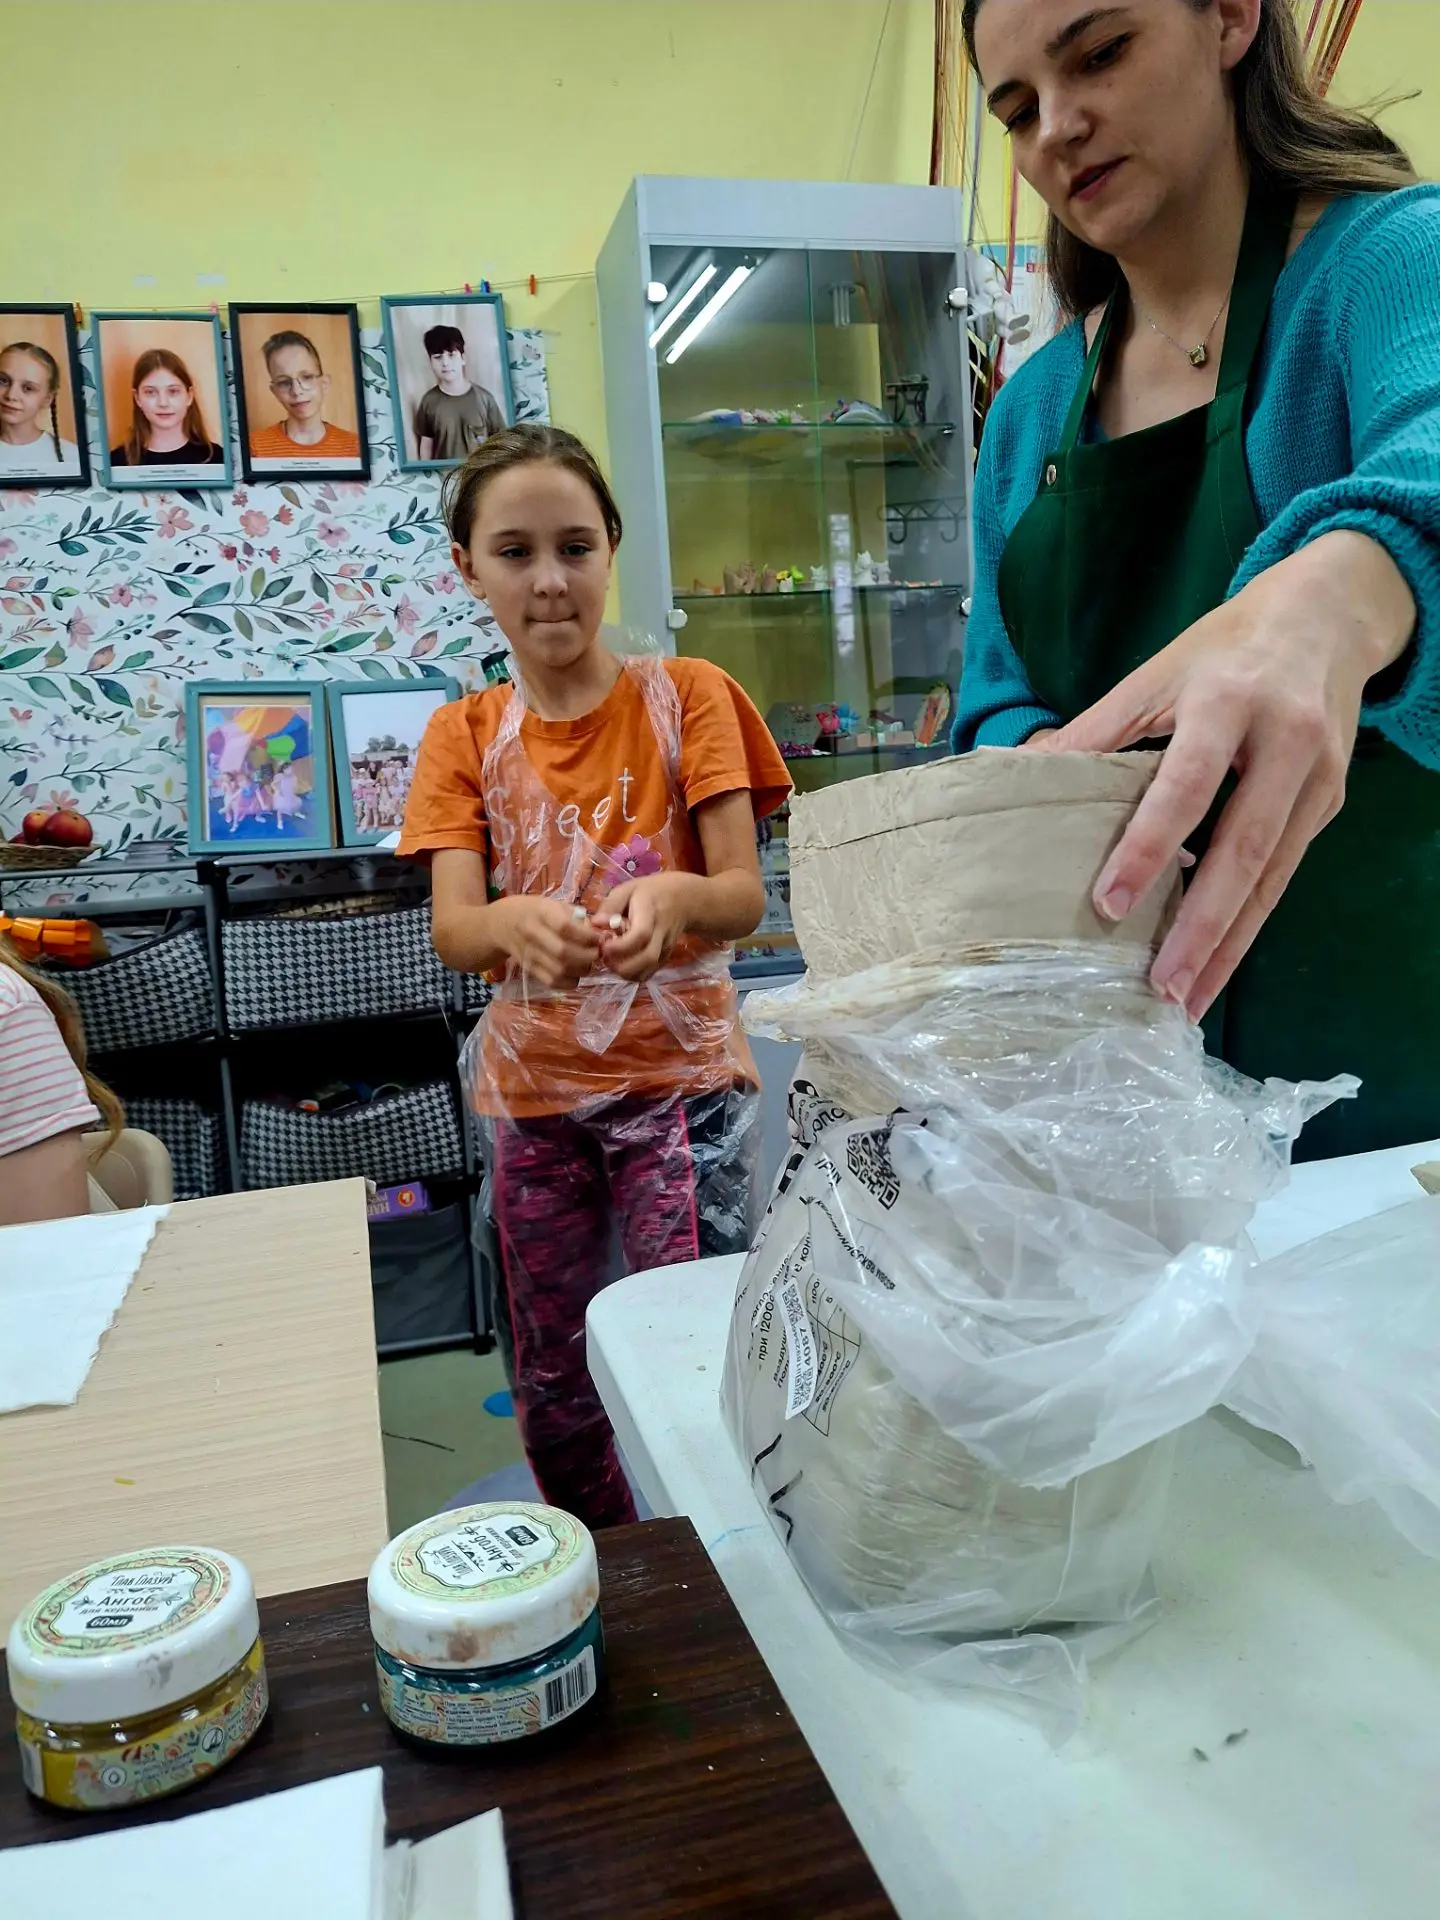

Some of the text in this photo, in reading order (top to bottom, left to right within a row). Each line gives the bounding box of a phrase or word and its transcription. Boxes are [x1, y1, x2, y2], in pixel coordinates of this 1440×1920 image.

[799, 1327, 811, 1366] 4087
[97, 1596, 152, 1607] Ангоб
[90, 1616, 129, 1628] 60мл
